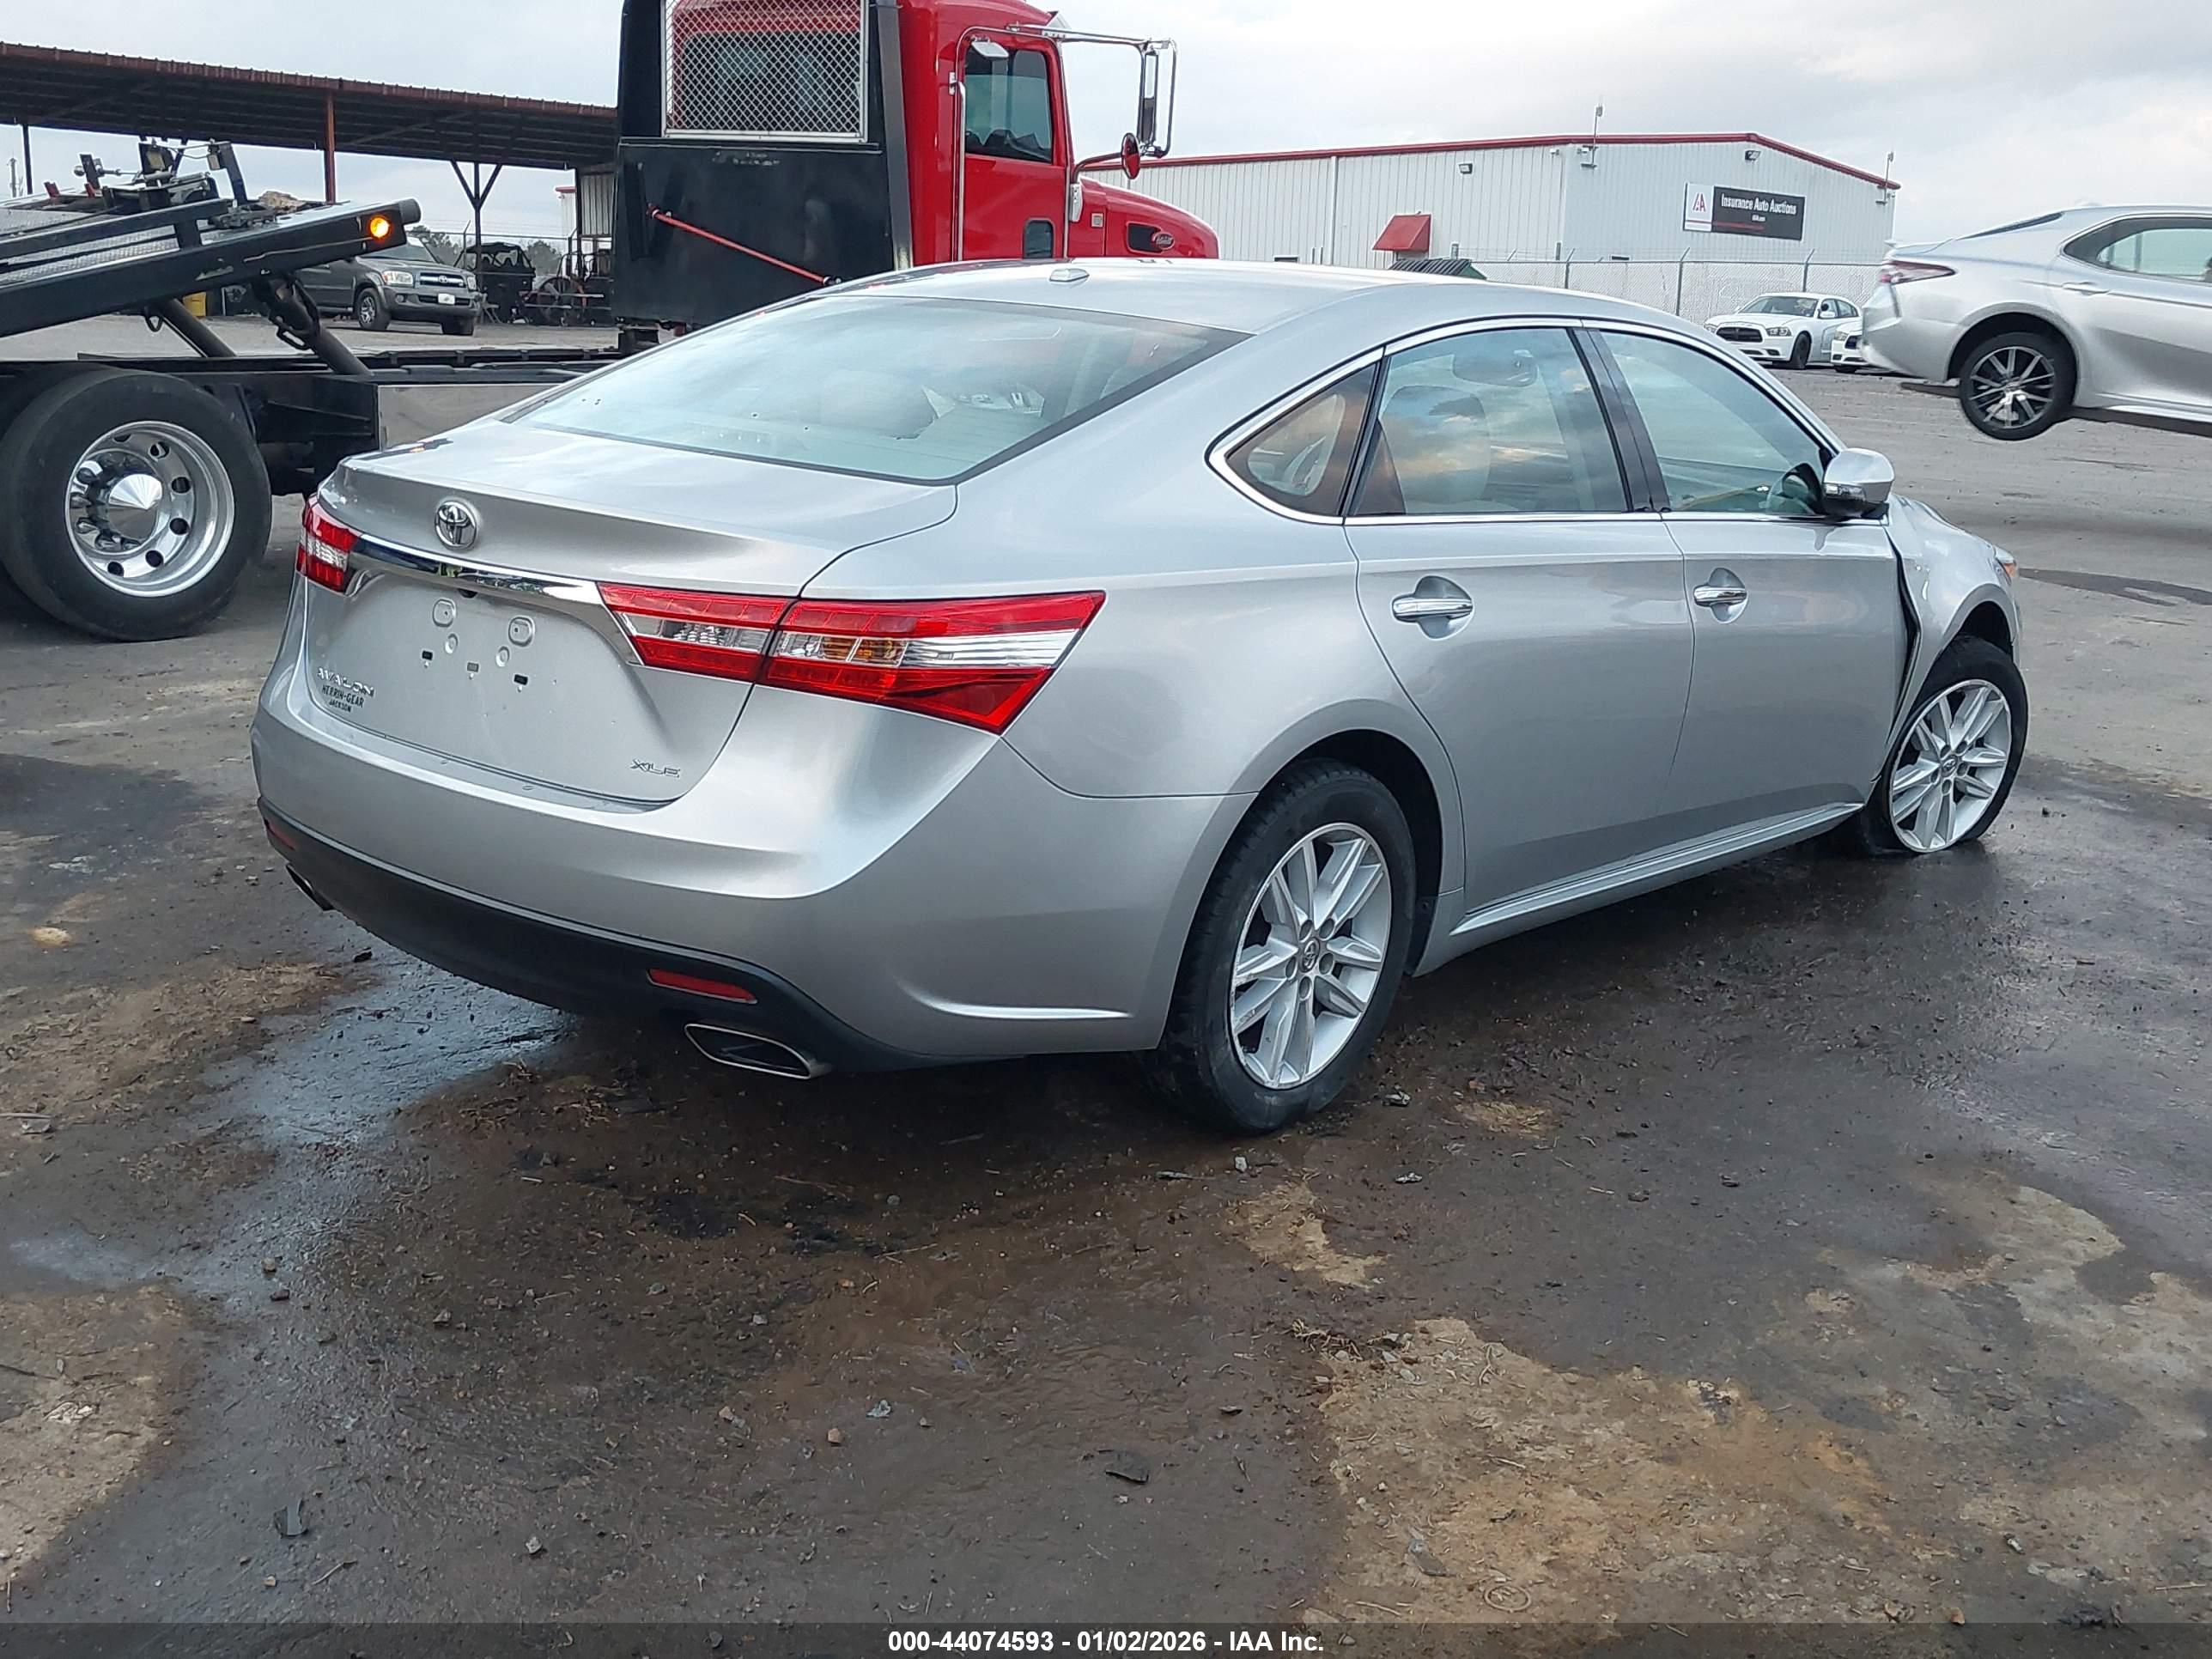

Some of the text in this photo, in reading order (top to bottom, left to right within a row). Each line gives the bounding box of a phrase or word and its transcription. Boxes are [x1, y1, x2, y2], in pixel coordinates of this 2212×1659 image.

[1721, 192, 1797, 215] Insurance Auto Auctions
[318, 667, 375, 697] AVALON
[630, 759, 681, 779] XLE
